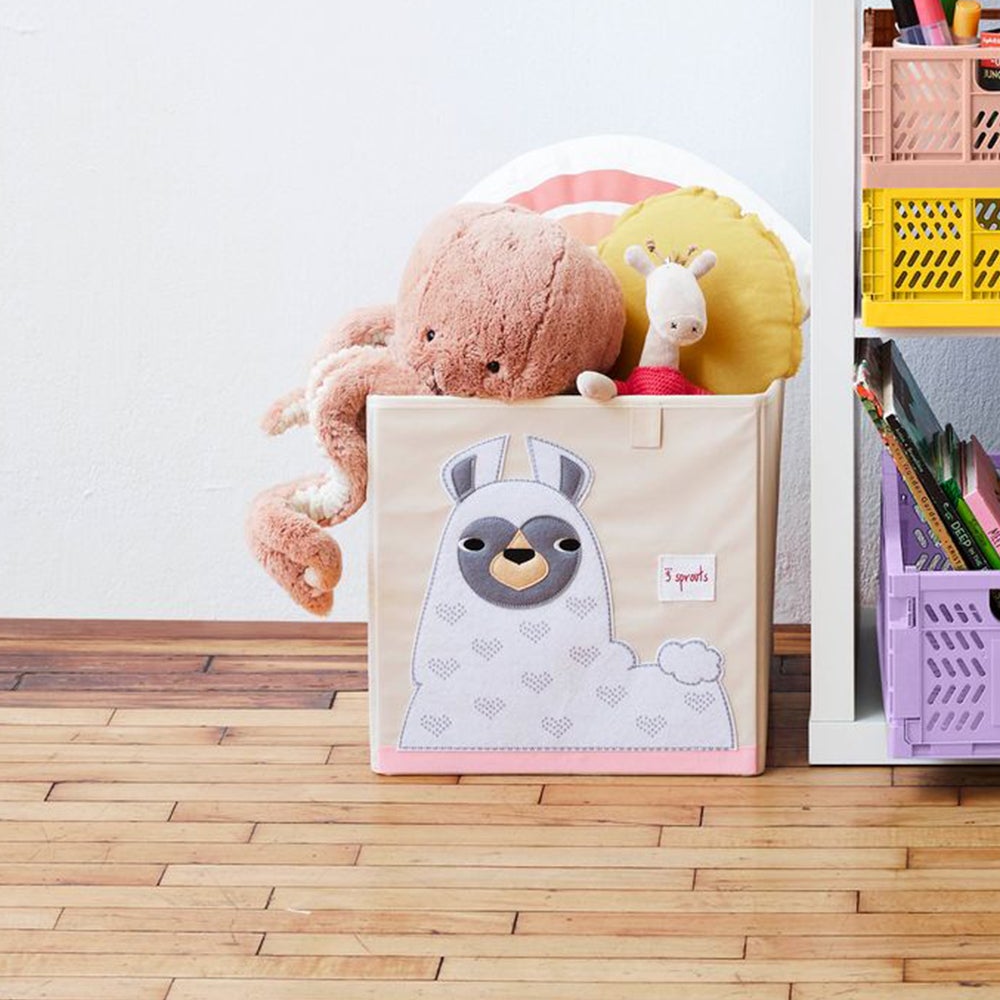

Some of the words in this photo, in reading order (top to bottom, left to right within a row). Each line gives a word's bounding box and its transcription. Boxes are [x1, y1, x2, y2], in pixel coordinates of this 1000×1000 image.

[951, 521, 972, 548] DEEP
[664, 567, 672, 582] 3
[675, 564, 708, 592] sprouts
